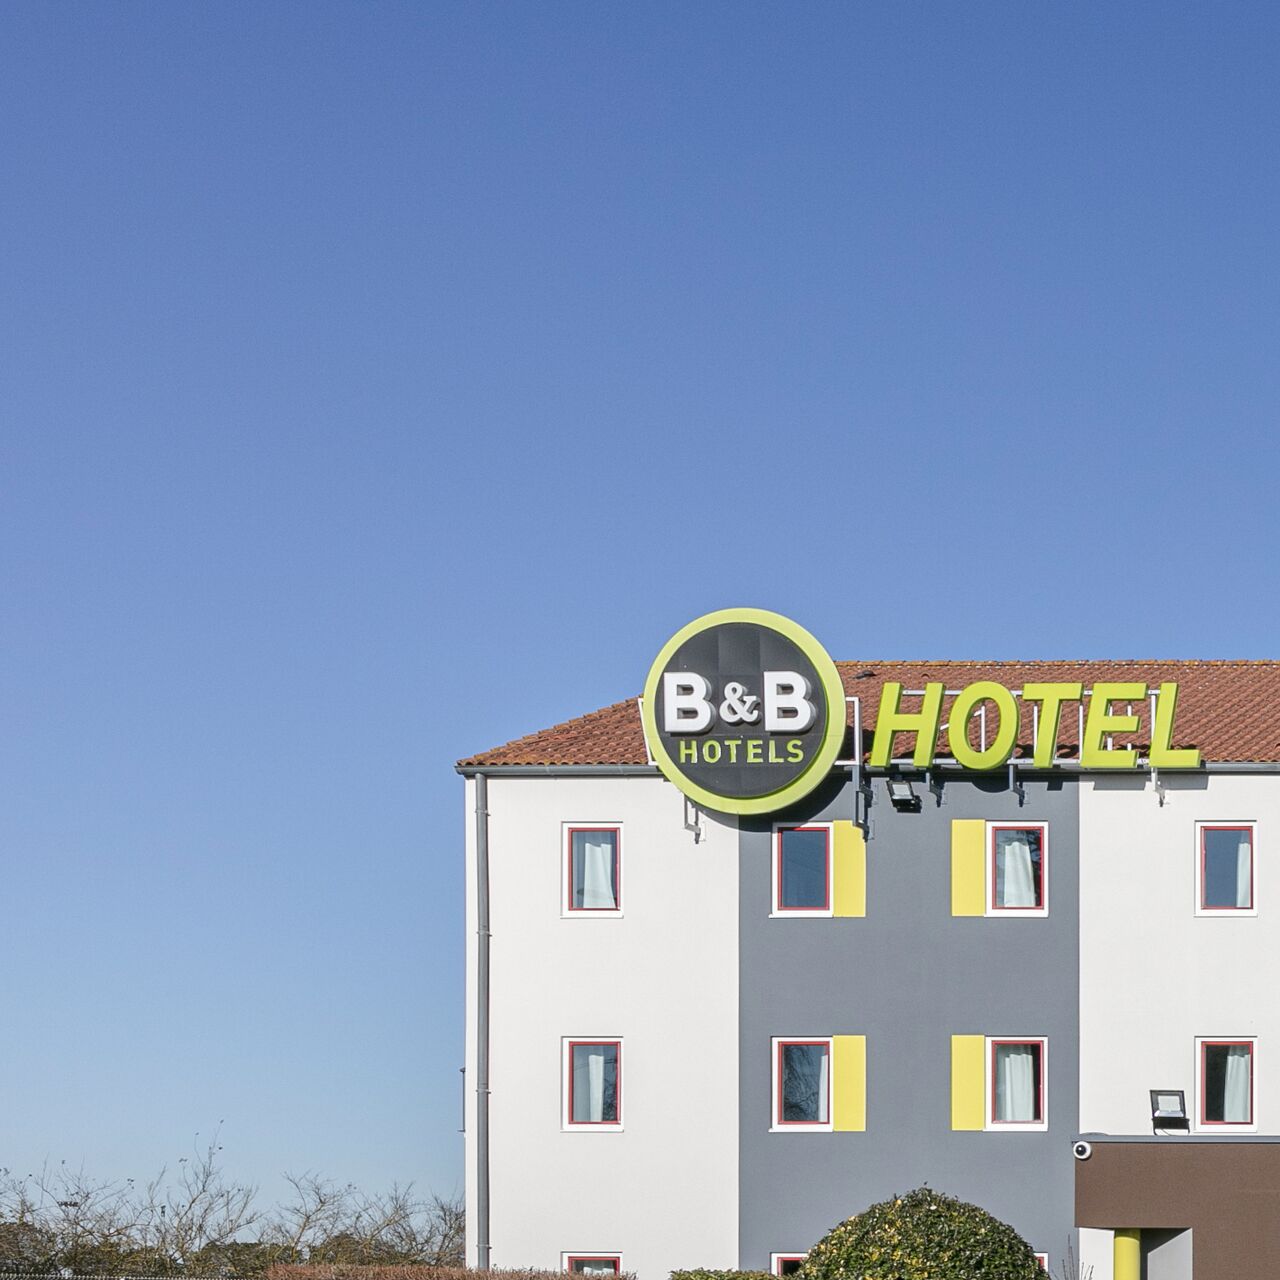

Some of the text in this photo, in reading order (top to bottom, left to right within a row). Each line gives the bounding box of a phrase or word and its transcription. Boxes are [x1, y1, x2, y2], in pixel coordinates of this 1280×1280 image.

[664, 671, 815, 733] B&B
[869, 681, 1201, 770] HOTEL
[679, 739, 805, 764] HOTELS
